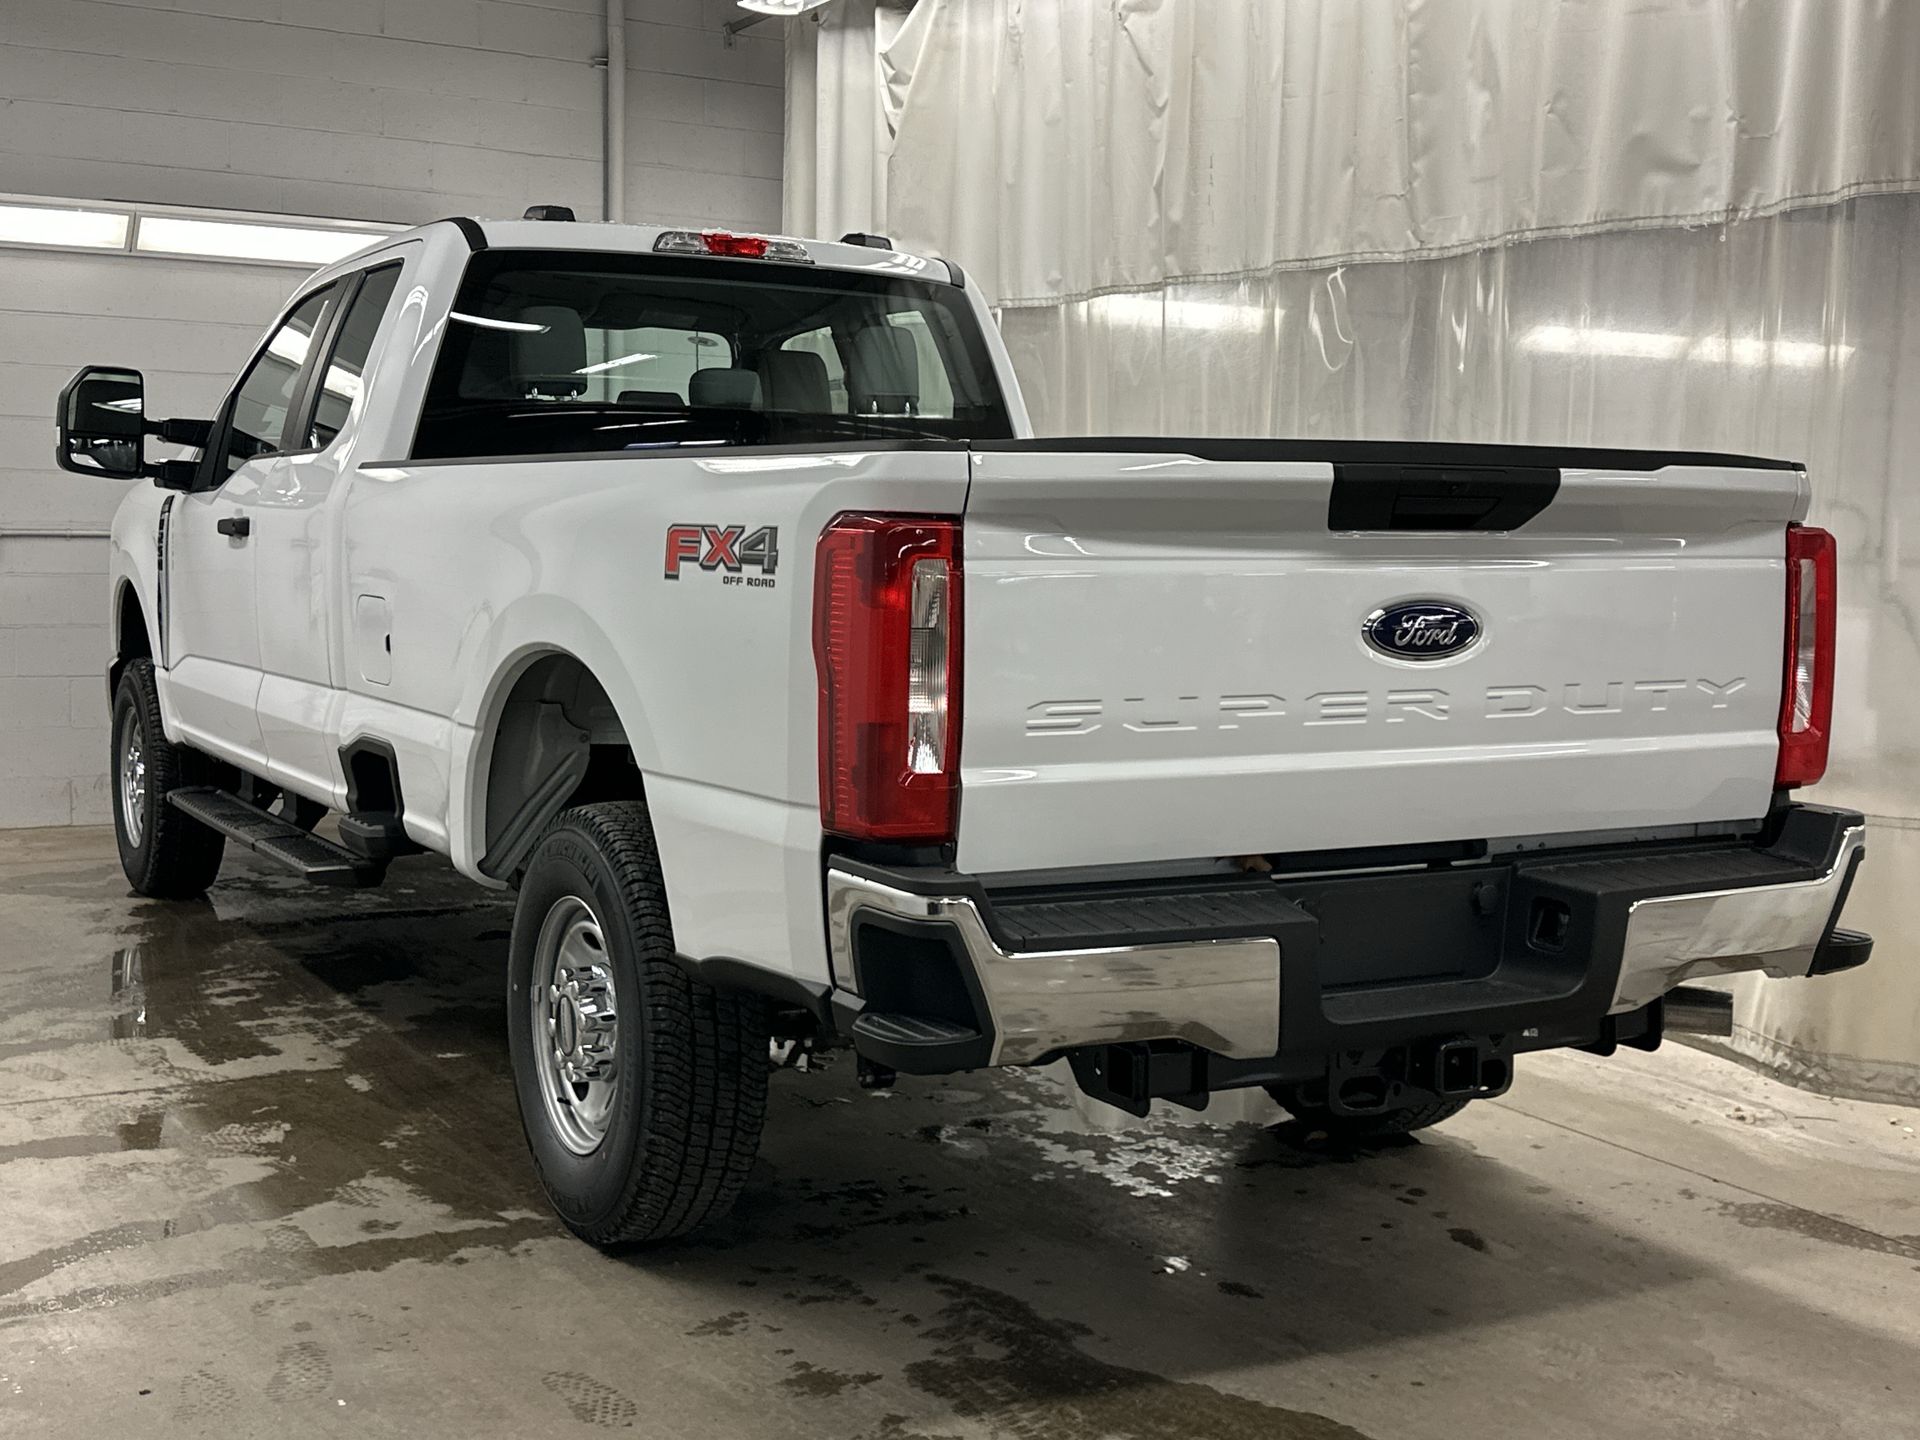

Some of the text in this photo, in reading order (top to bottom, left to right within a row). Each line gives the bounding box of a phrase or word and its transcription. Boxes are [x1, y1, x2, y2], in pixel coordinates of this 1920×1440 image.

[664, 523, 778, 579] FX4
[722, 575, 776, 588] OFF ROAD
[1395, 614, 1458, 646] Ford
[1025, 676, 1747, 737] SUPER DUTY
